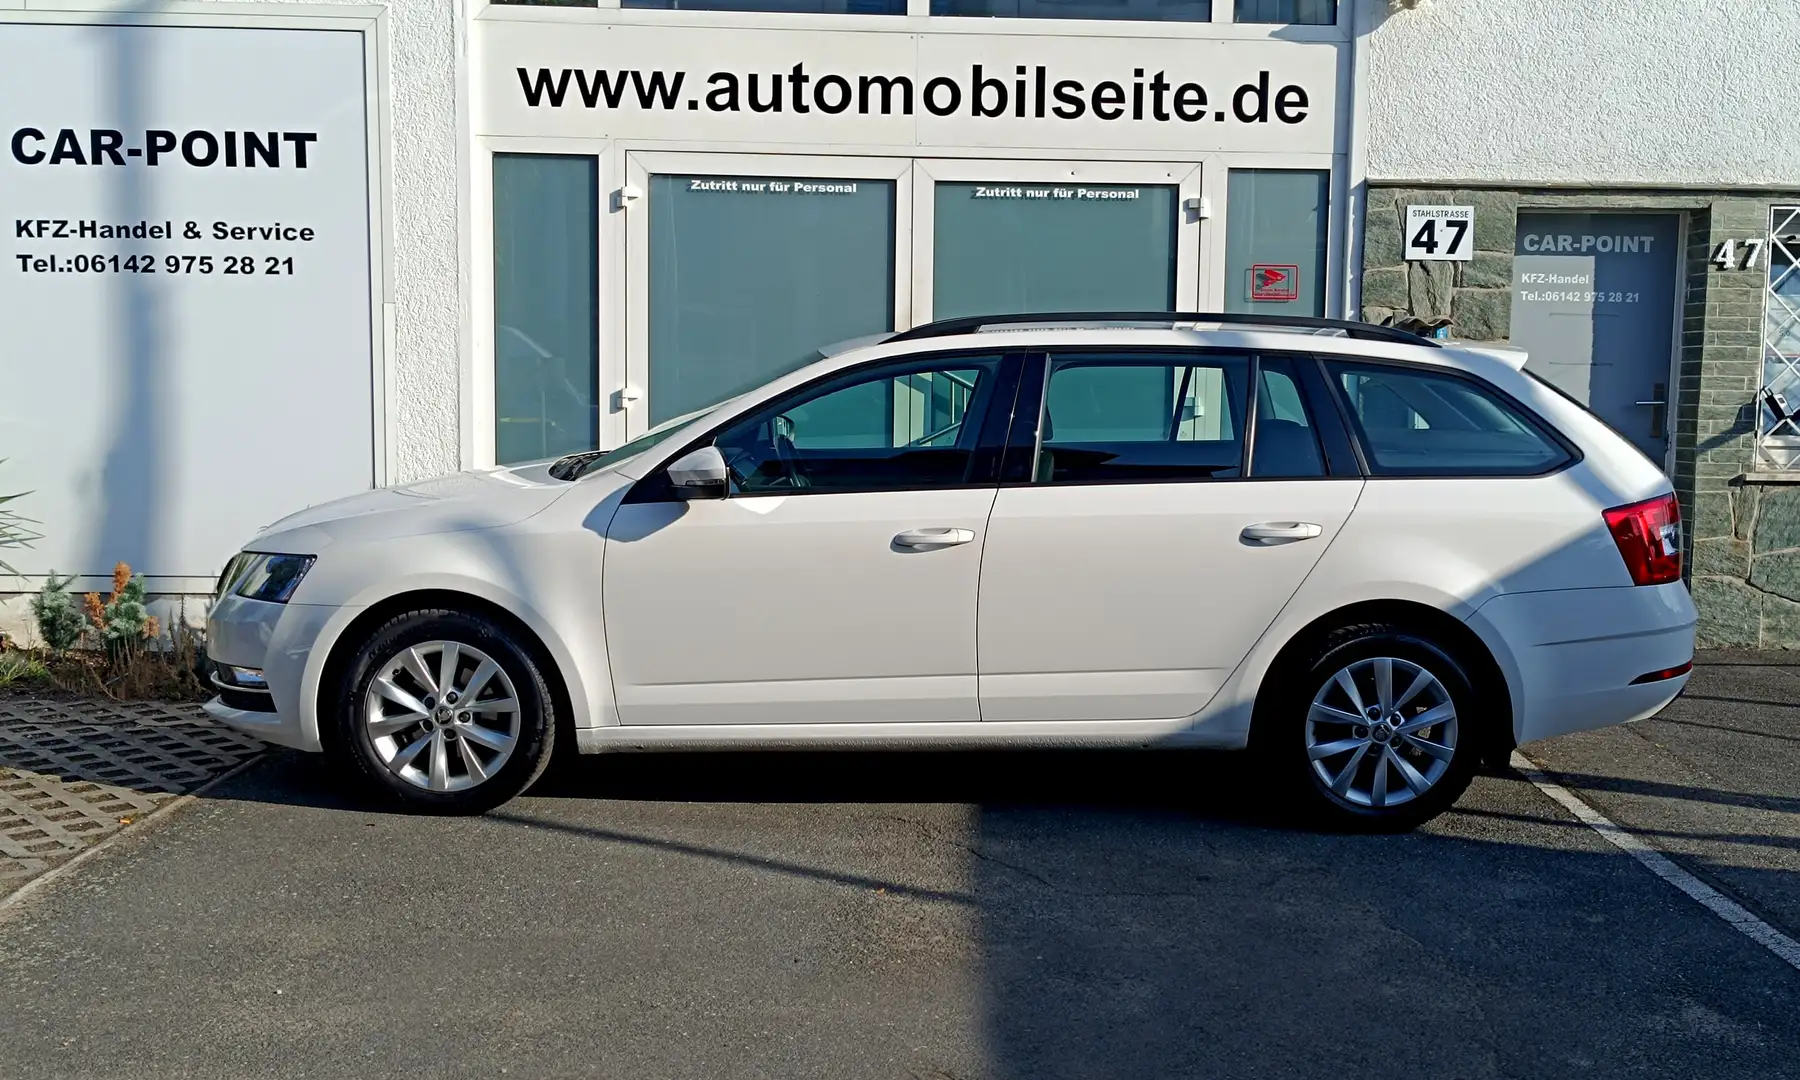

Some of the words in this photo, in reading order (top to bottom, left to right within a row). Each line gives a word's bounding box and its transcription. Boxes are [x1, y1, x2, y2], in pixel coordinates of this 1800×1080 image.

[516, 61, 1309, 125] www.automobilseite.de
[11, 127, 318, 169] CAR-POINT
[690, 179, 738, 191] Zutritt
[741, 183, 767, 192] nur
[769, 181, 791, 192] für
[794, 182, 857, 193] Personal
[975, 186, 1023, 198] Zutritt
[1026, 189, 1051, 198] nur
[1053, 187, 1075, 199] für
[1078, 188, 1140, 199] Personal
[1412, 209, 1470, 219] STAHLSTRASSE
[15, 219, 172, 240] KFZ-Handel
[182, 221, 203, 240] &
[212, 221, 315, 242] Service
[1411, 219, 1469, 255] 47
[1523, 233, 1655, 254] CAR-POINT
[1714, 238, 1765, 269] 47
[15, 254, 156, 274] Tel.:06142
[165, 255, 214, 275] 975
[223, 256, 256, 275] 28
[264, 256, 295, 275] 21
[1521, 273, 1590, 285] KFZ-Handel
[1521, 290, 1581, 302] Tel.:06142
[1584, 291, 1606, 303] 975
[1608, 292, 1623, 303] 28
[1625, 292, 1640, 303] 21
